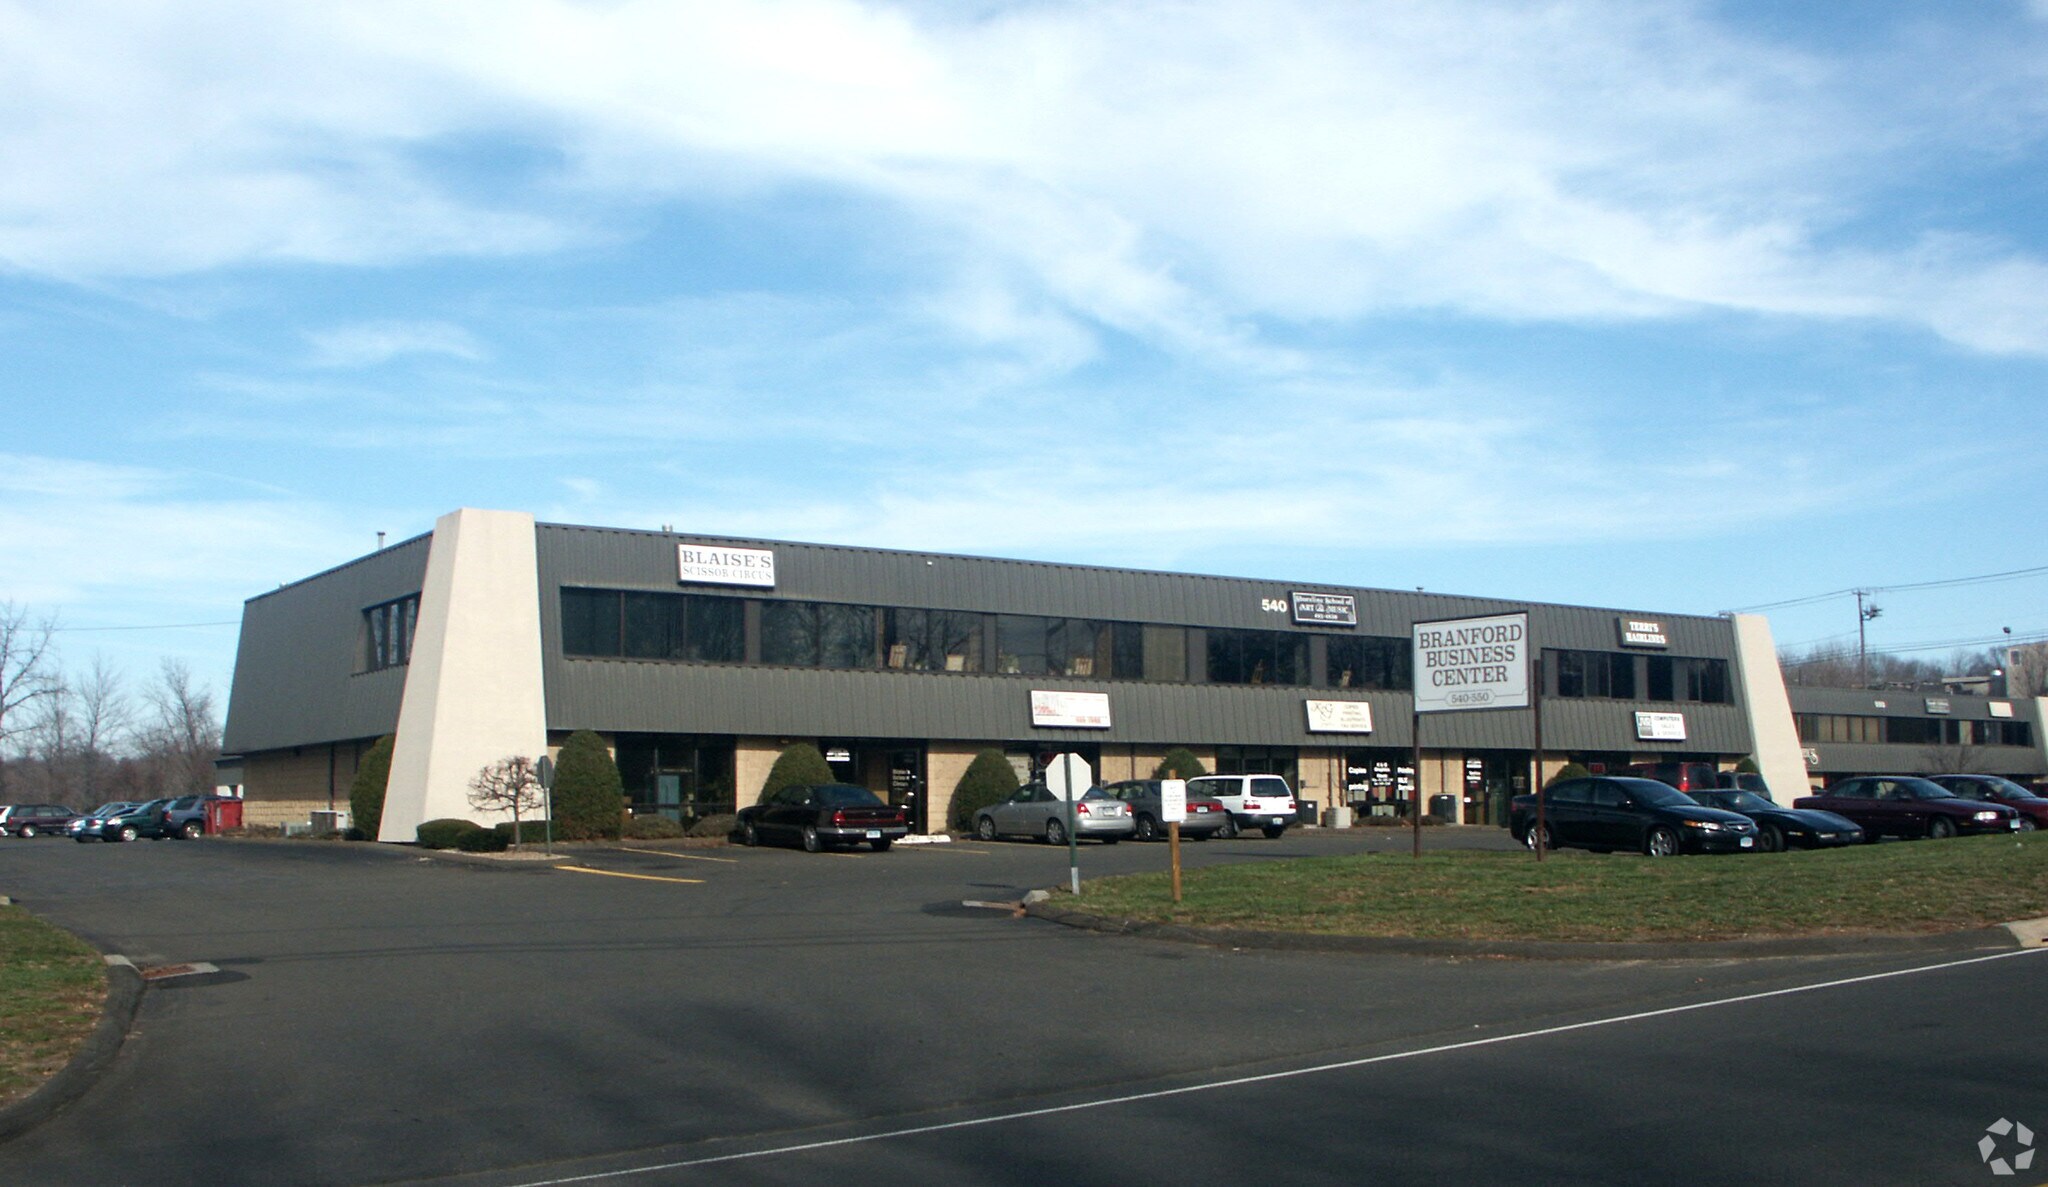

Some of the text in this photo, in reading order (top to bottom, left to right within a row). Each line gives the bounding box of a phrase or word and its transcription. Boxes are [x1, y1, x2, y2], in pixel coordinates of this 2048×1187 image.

[682, 550, 772, 569] BLAISE'S
[683, 566, 772, 580] SCISSOR CIRCUS
[1261, 599, 1288, 613] 540
[1419, 624, 1523, 649] BRANFORD
[1426, 645, 1516, 668] BUSINESS
[1432, 665, 1508, 687] CENTER
[1451, 692, 1490, 704] 540-550
